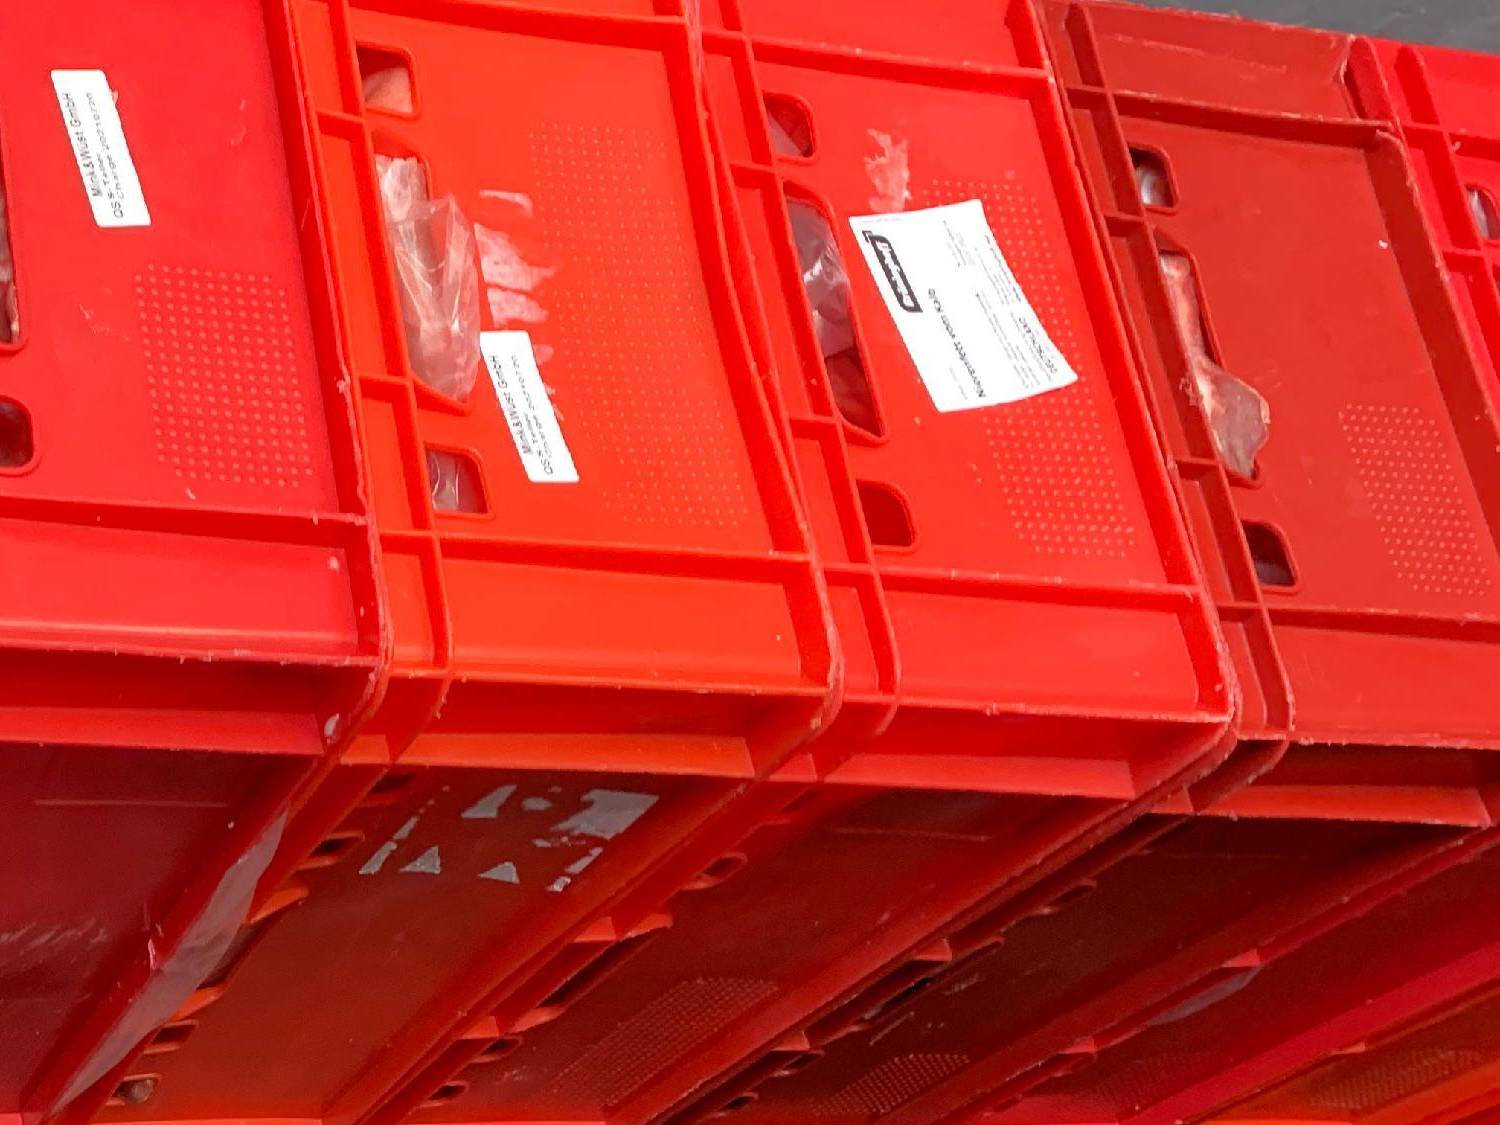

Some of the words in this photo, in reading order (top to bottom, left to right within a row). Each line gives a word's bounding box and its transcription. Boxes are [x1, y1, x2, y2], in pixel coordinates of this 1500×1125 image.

[63, 92, 82, 127] GmbH
[106, 154, 124, 200] Charge
[488, 355, 508, 388] GmbH
